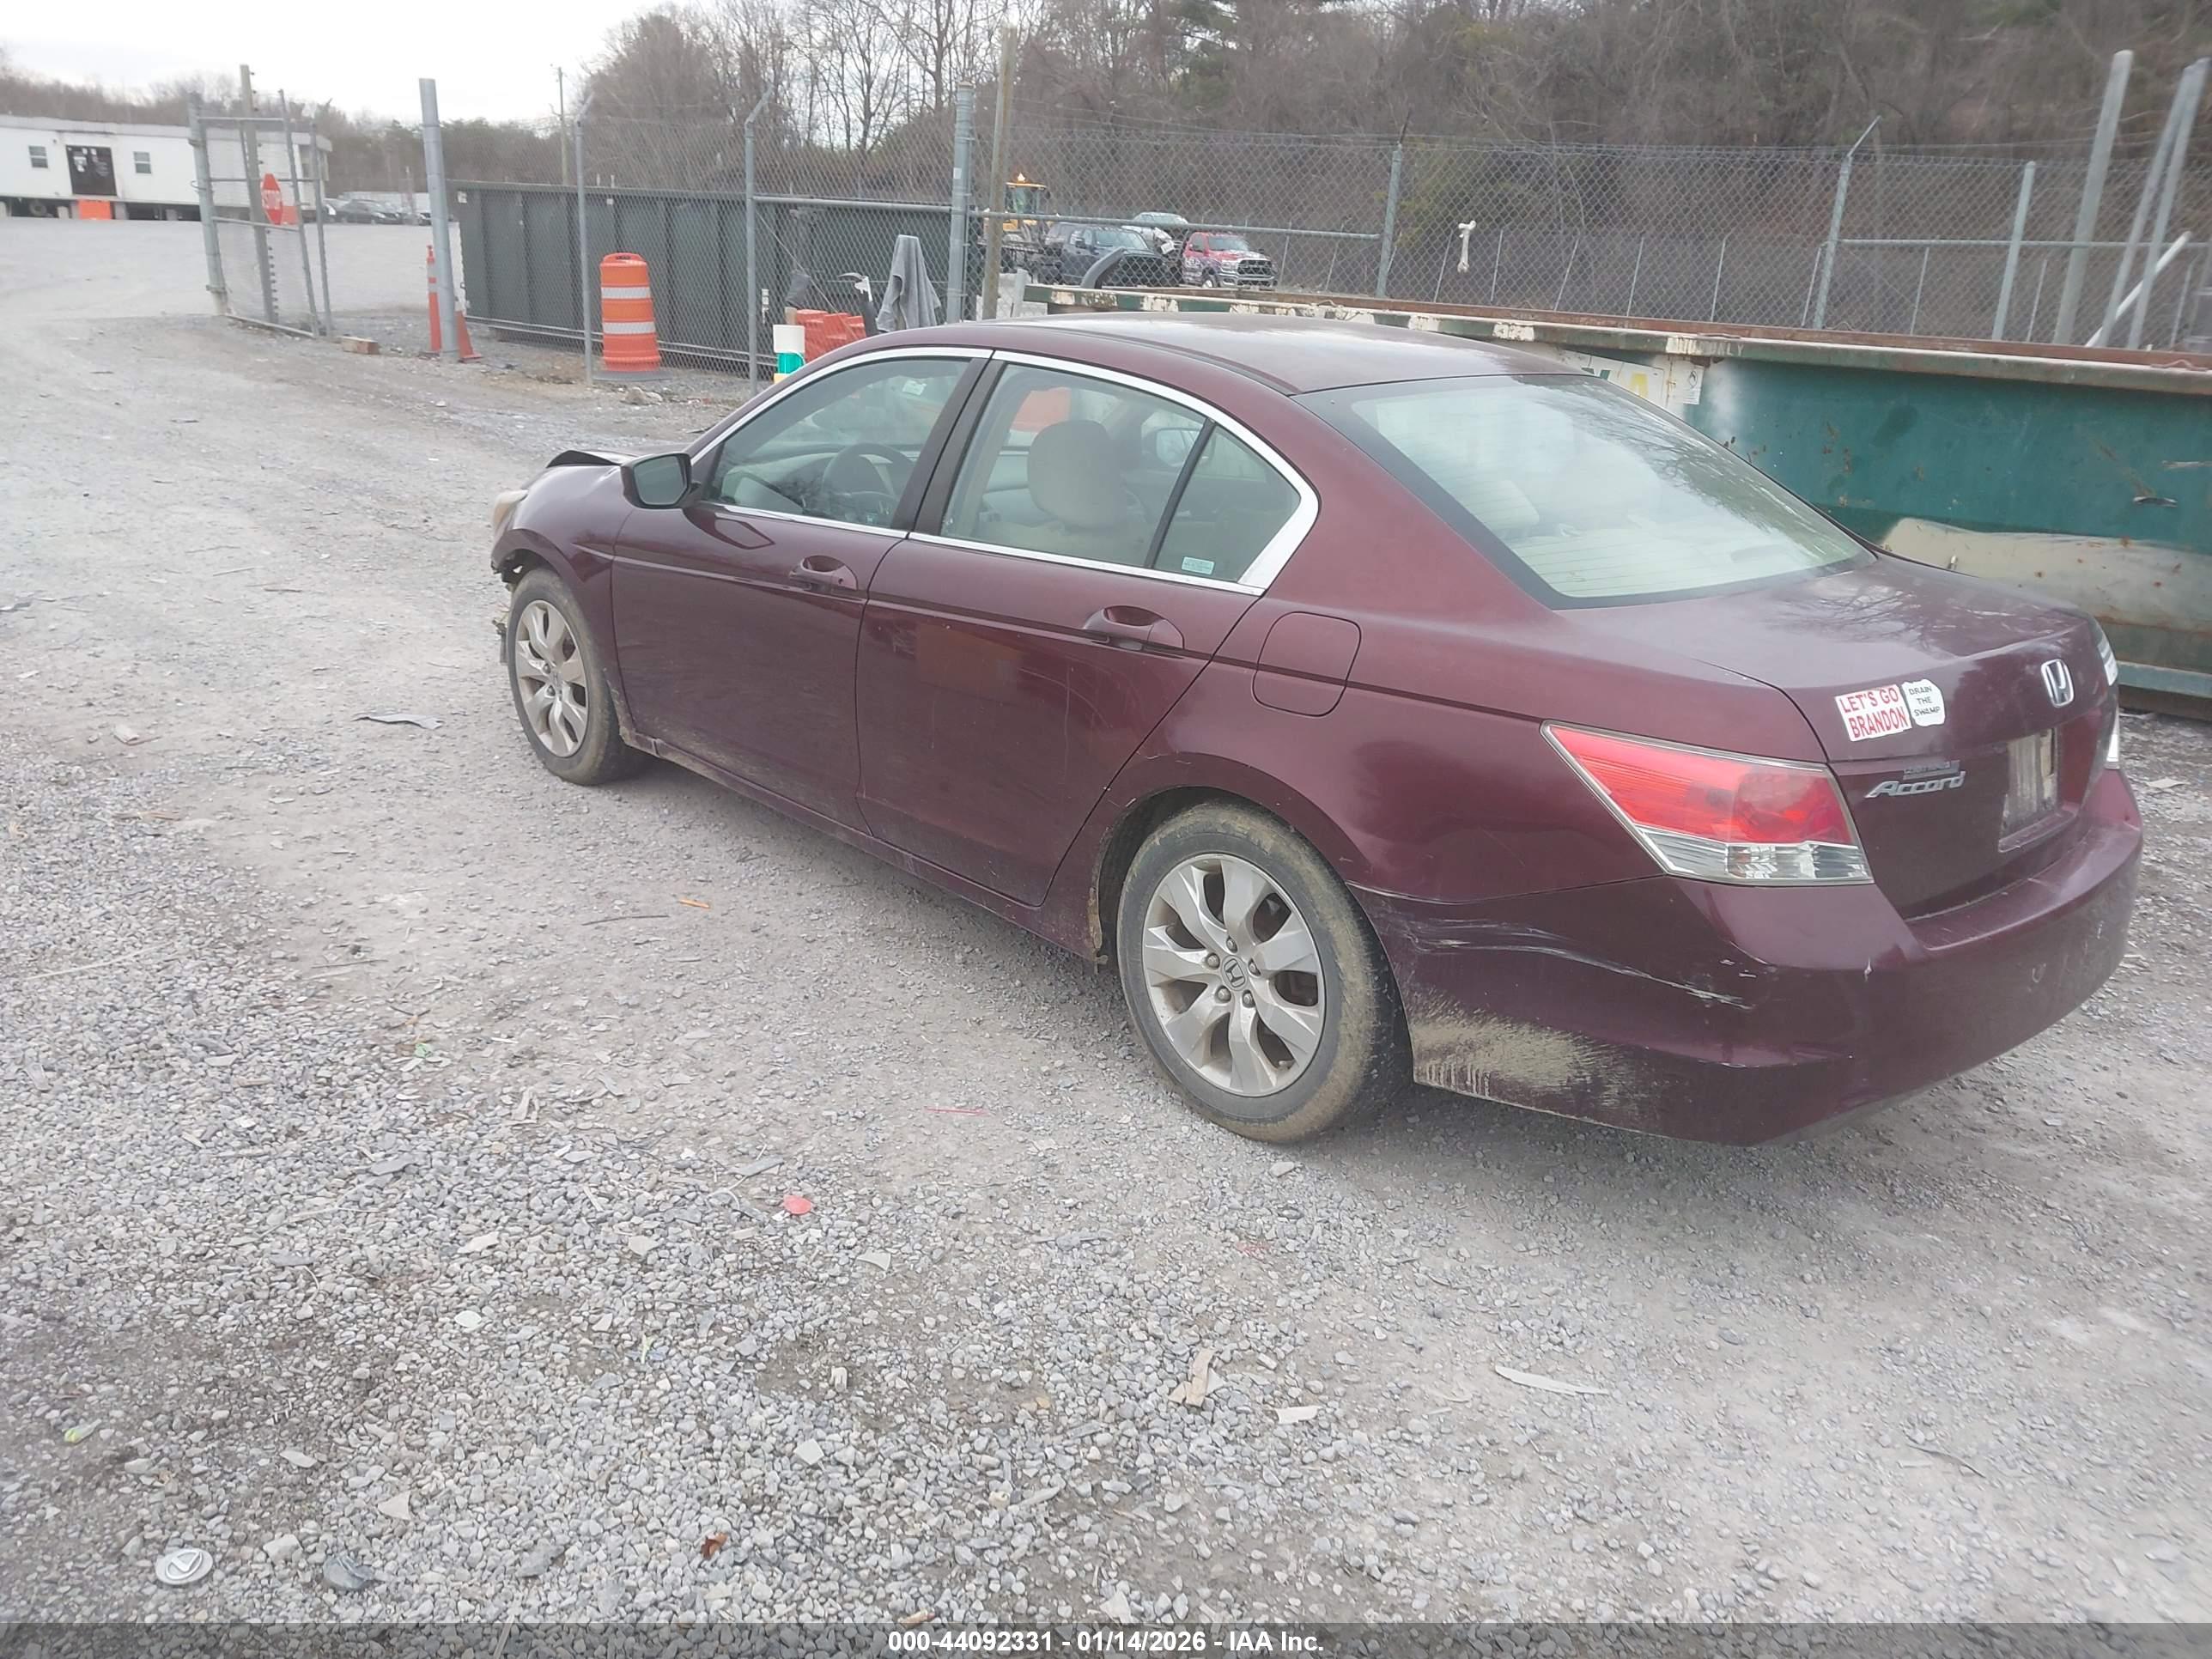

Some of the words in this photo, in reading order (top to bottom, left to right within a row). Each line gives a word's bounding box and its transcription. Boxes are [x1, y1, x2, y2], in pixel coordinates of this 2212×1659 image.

[1908, 686, 1933, 696] DRAIN
[1840, 691, 1878, 713] LET'S
[1880, 688, 1899, 704] GO
[1917, 696, 1933, 705] THE
[1914, 707, 1941, 716] SWAMP
[1849, 706, 1908, 738] BRANDON
[1864, 771, 1966, 798] Accord
